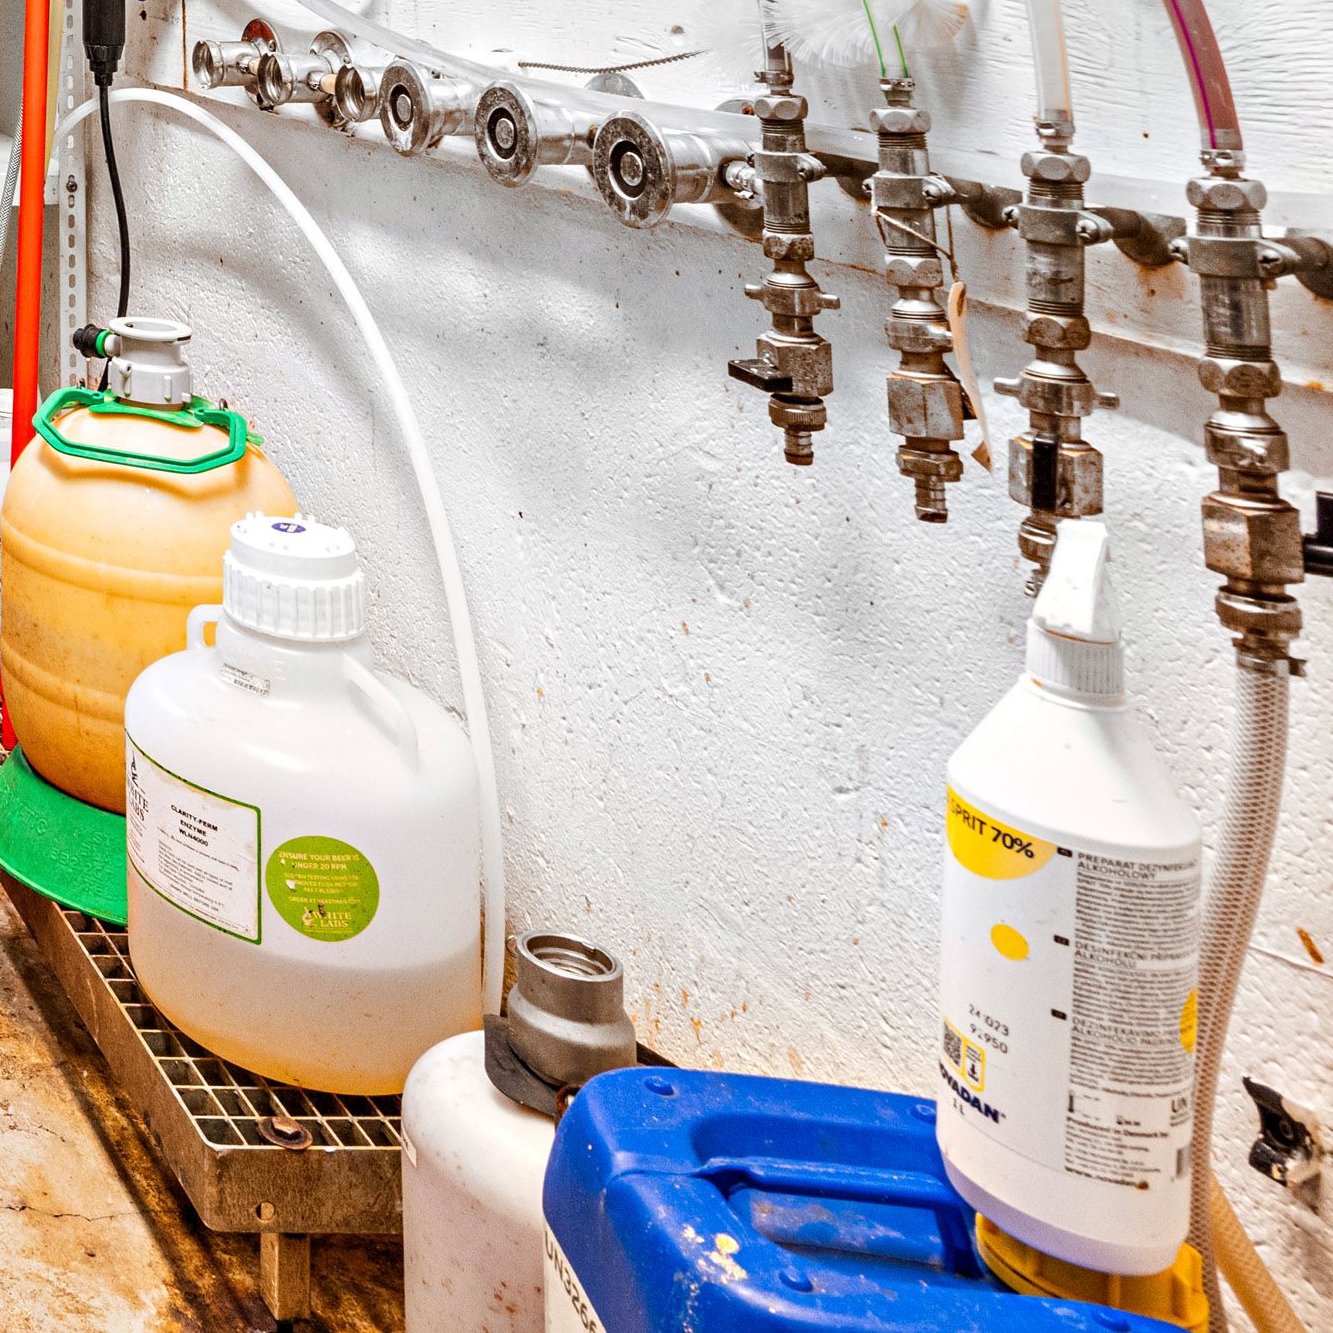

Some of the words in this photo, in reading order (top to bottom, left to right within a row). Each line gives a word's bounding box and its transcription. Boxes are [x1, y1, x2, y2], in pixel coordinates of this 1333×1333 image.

[170, 804, 219, 832] CLARITY-FERM
[179, 819, 208, 837] ENZYME
[990, 825, 1036, 859] 70%
[309, 853, 331, 861] YOUR
[1077, 852, 1135, 869] PREPARAT
[1077, 861, 1157, 880] ALKOHOLOWY
[321, 919, 349, 928] LABS
